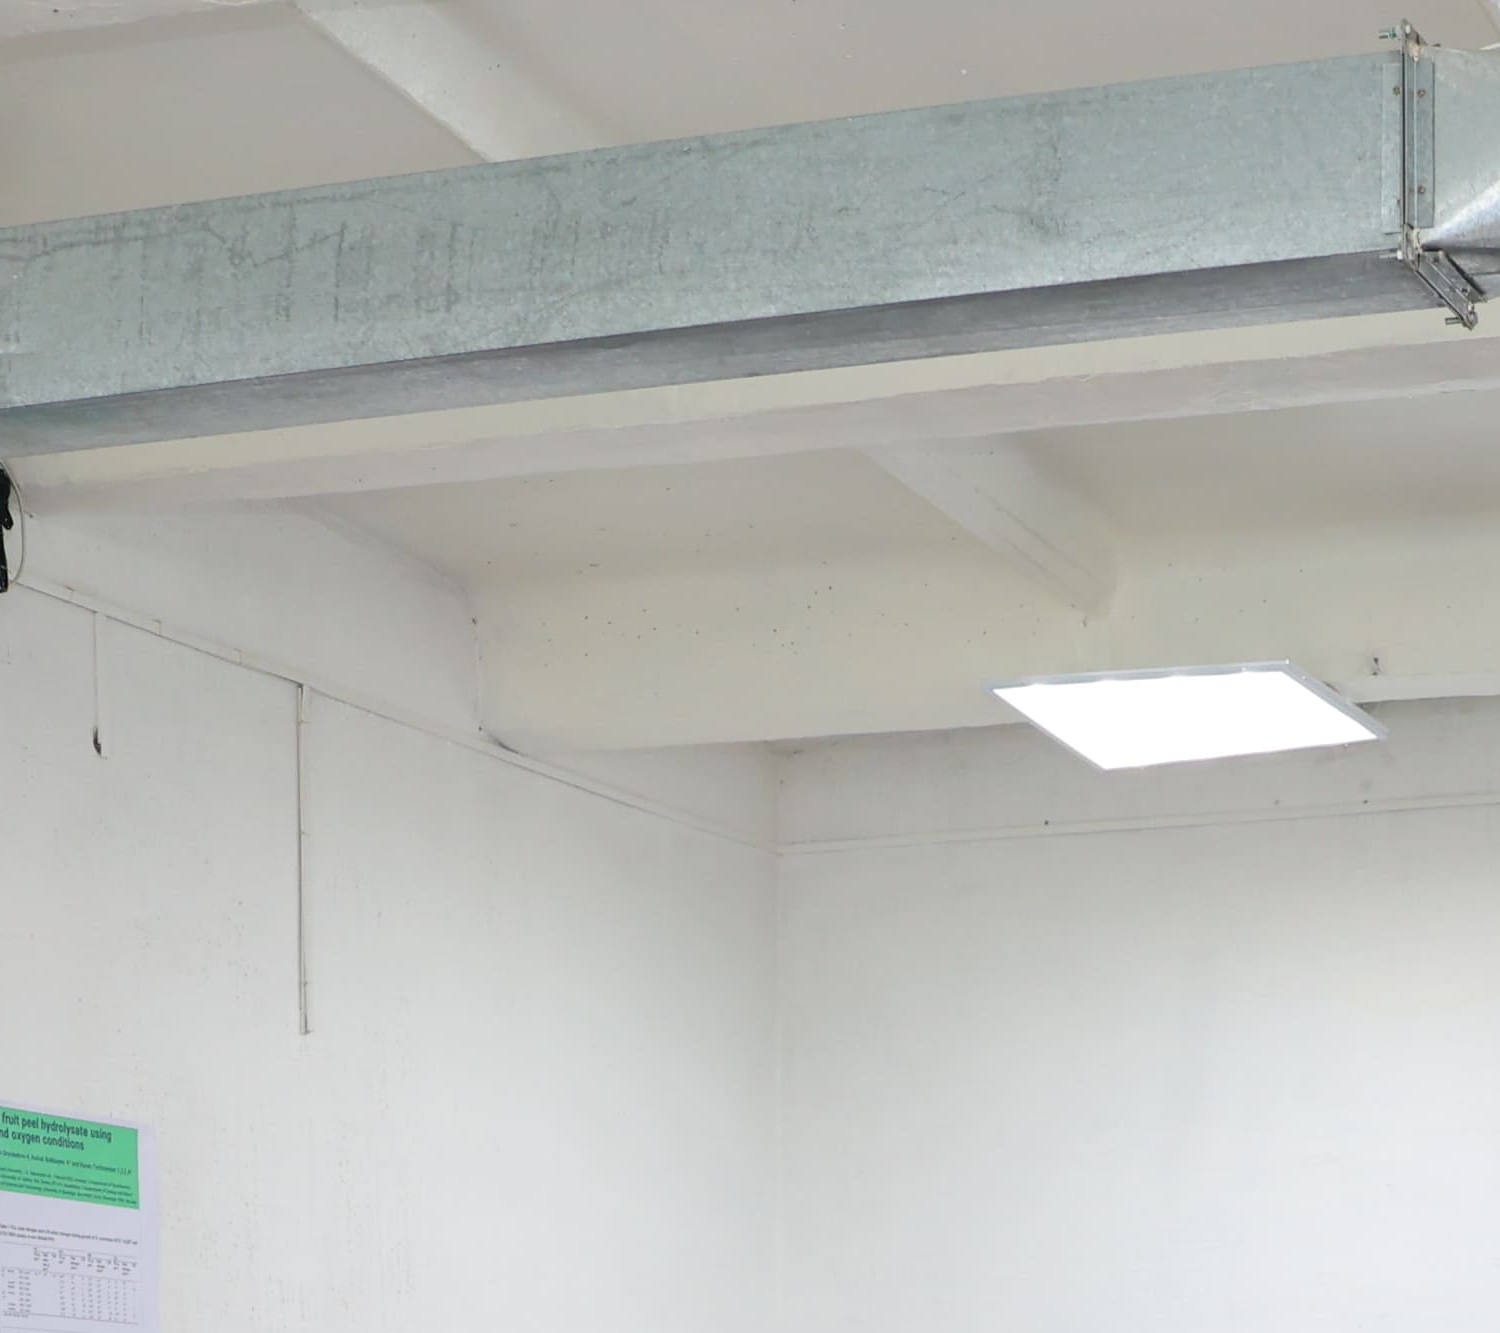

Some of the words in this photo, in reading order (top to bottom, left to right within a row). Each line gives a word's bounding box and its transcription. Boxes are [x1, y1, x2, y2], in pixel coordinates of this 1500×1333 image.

[1, 1111, 20, 1126] fruit
[21, 1116, 39, 1130] peel
[40, 1118, 88, 1137] hydrolysate
[90, 1127, 112, 1143] using
[11, 1130, 41, 1145] oxygen
[42, 1134, 85, 1151] conditions
